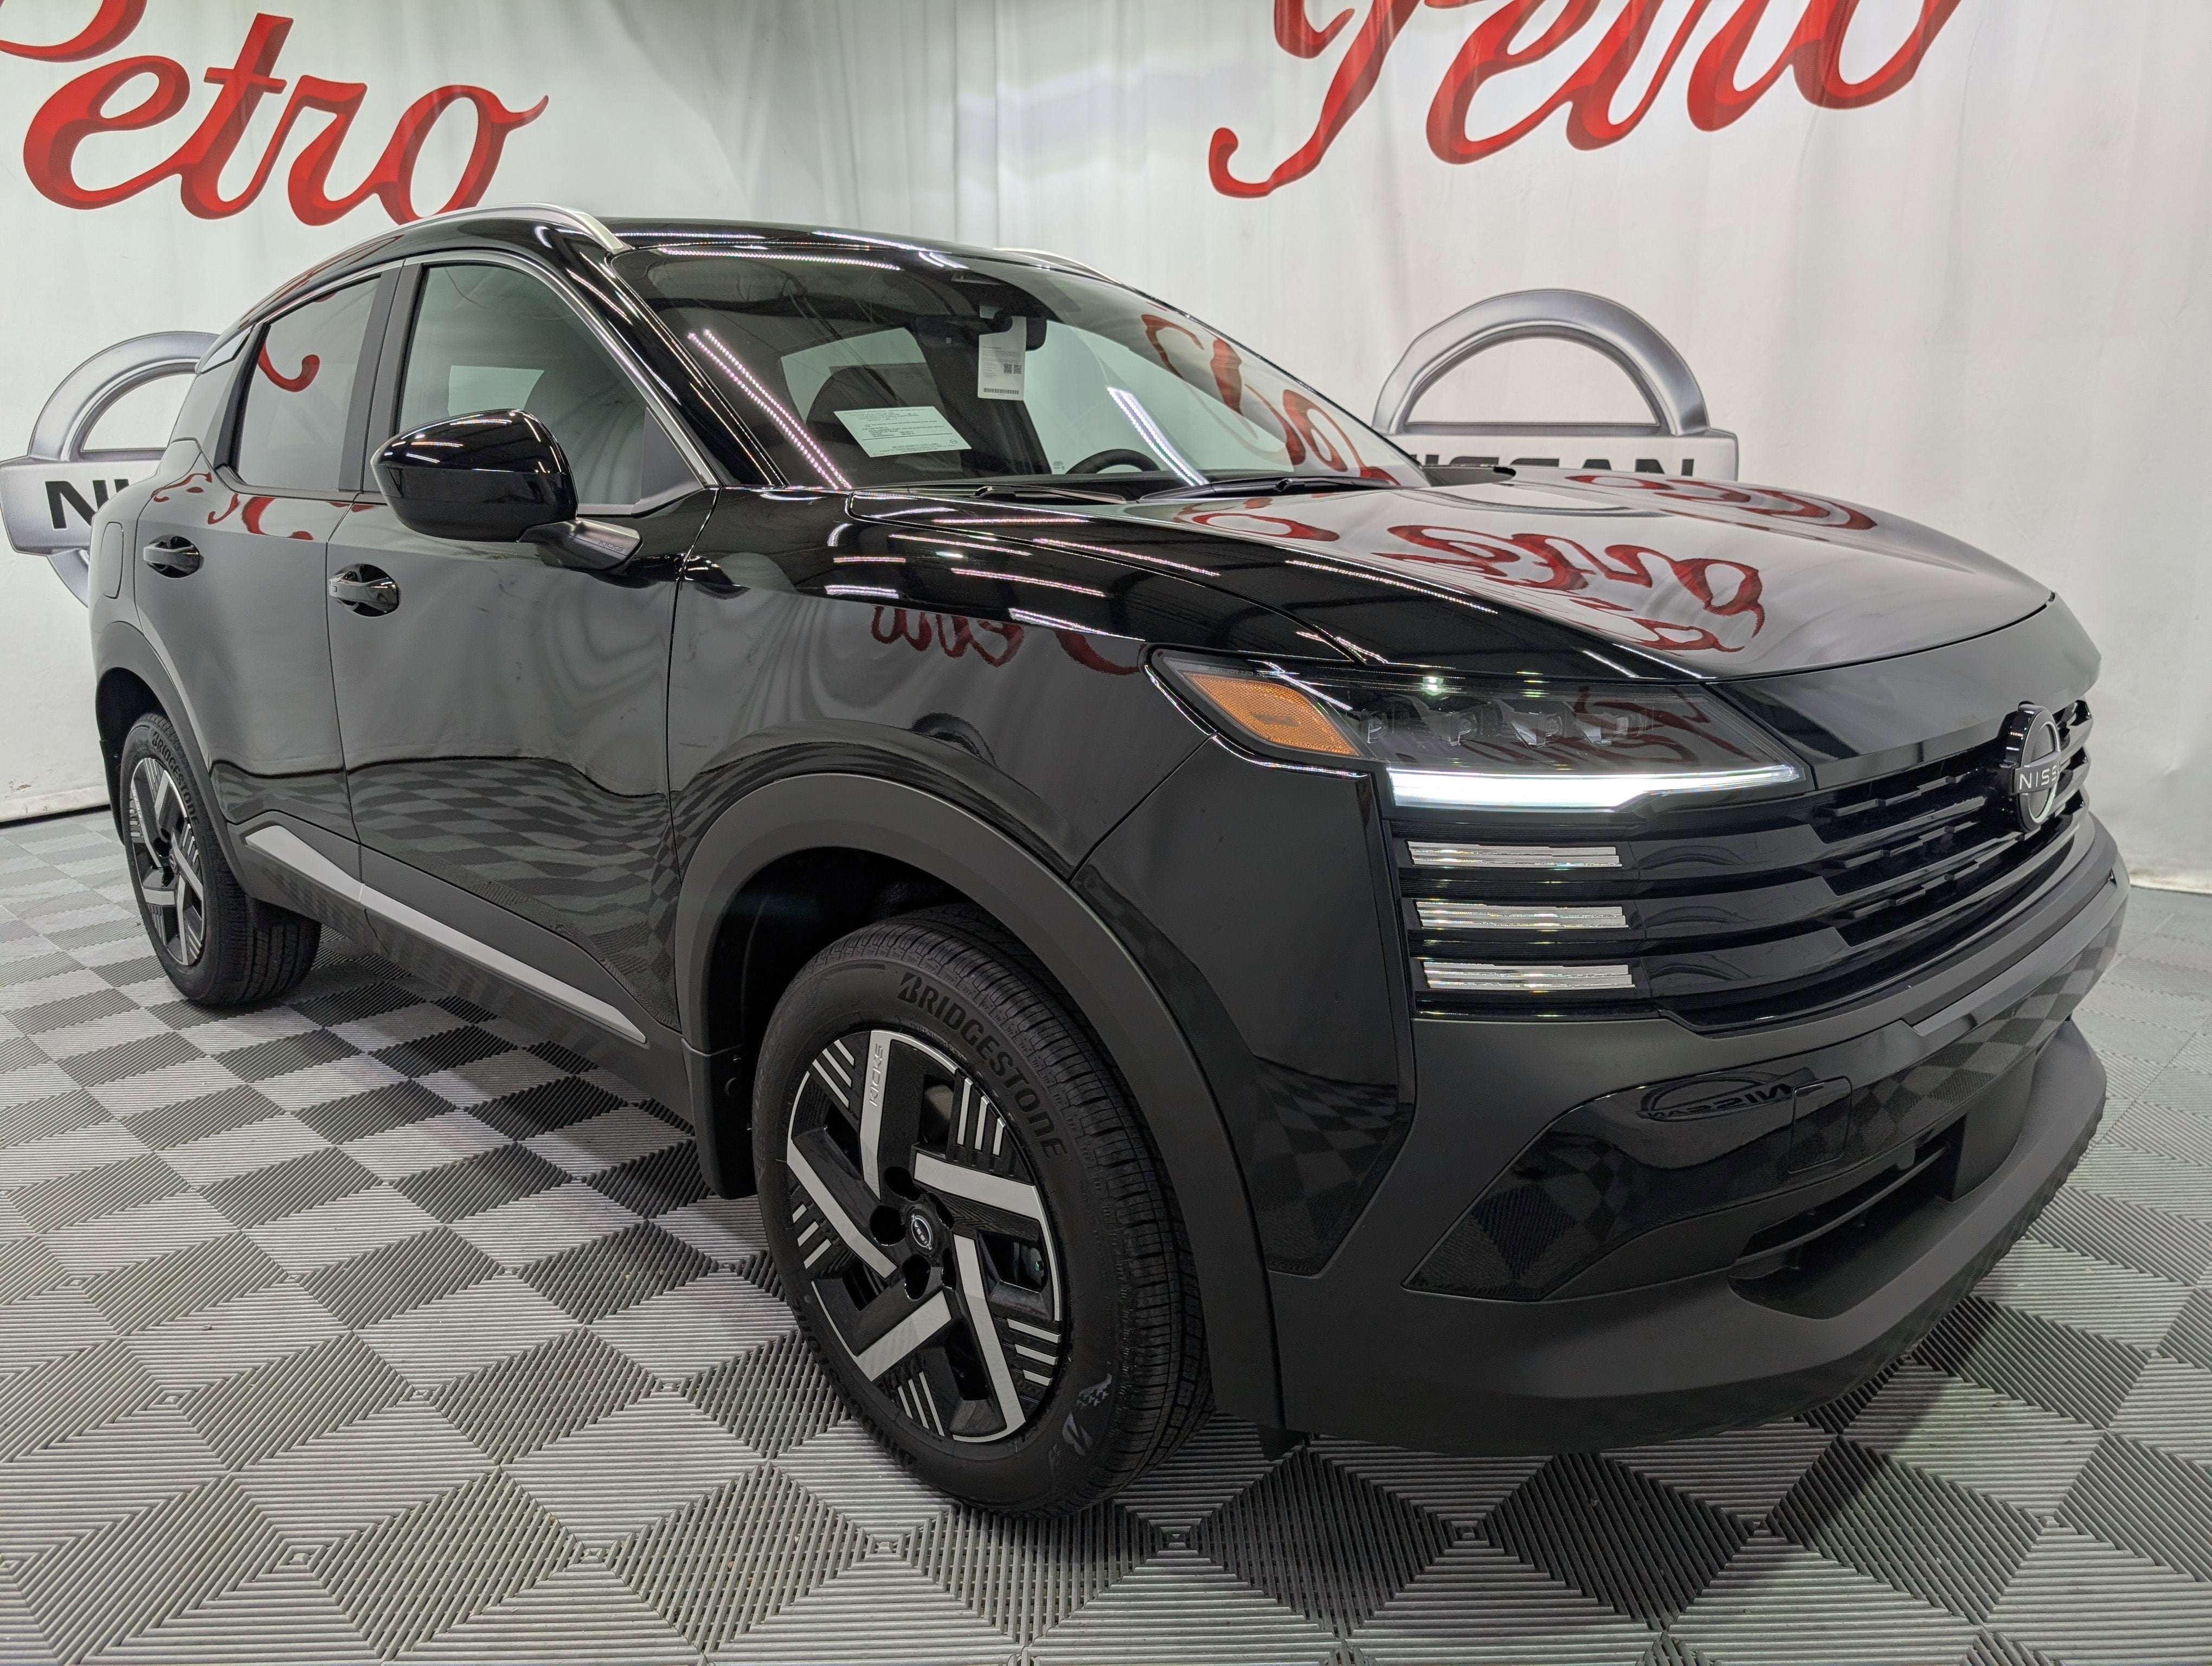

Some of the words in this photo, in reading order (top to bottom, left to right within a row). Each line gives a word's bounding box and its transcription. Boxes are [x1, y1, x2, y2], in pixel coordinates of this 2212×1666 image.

[152, 731, 200, 825] BRIDGESTONE
[2019, 765, 2059, 790] NISS
[869, 1043, 884, 1107] KICKS
[897, 972, 1070, 1159] BRIDGESTONE
